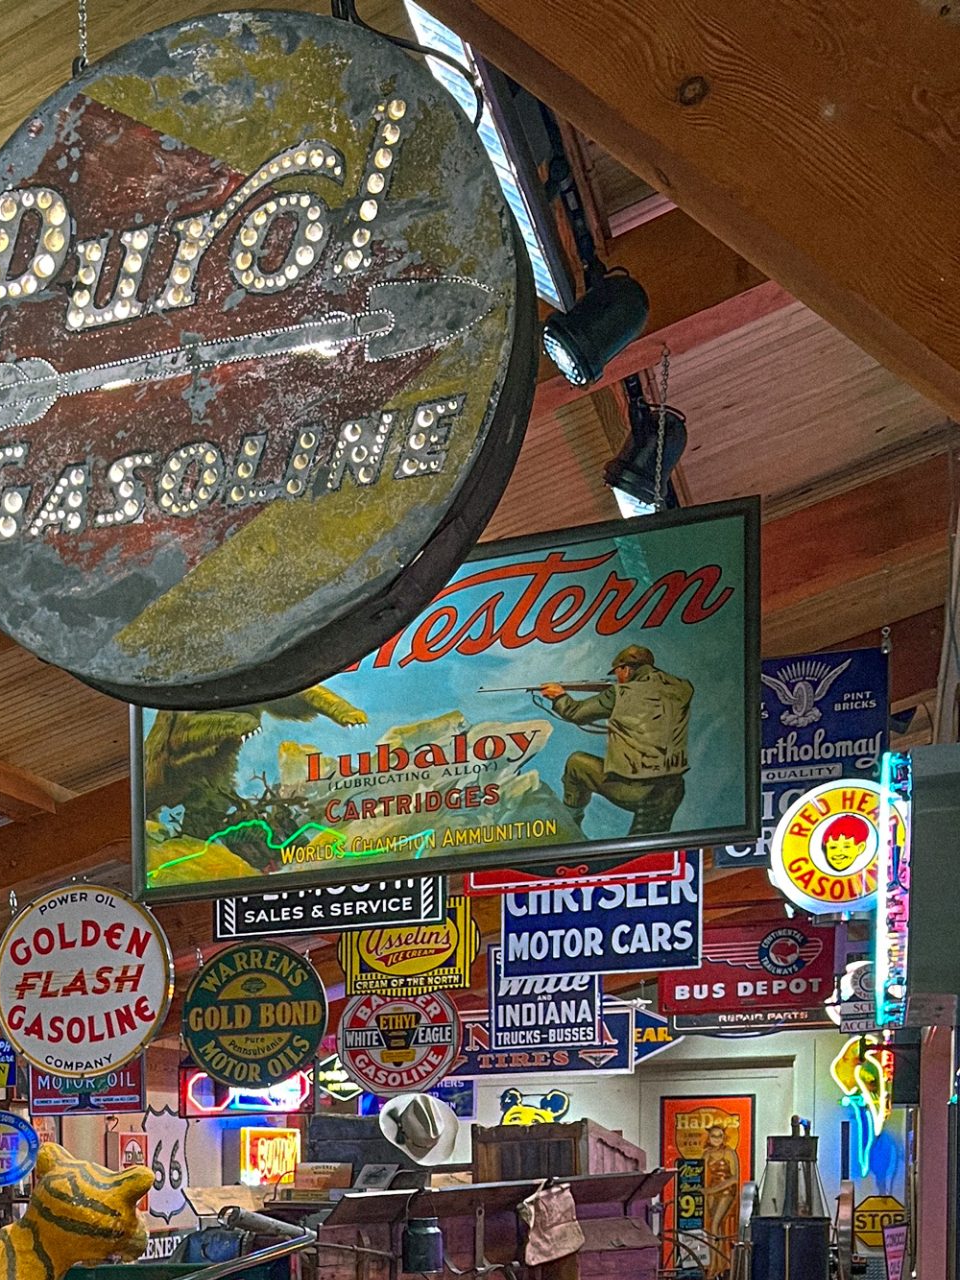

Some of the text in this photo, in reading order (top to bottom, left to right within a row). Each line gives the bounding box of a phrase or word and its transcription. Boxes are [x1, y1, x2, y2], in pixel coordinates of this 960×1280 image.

[833, 700, 877, 711] BRICKS
[843, 691, 872, 701] PINT
[305, 729, 544, 783] Lubaloy
[328, 761, 499, 792] (LUBRICATING ALLOY)
[766, 767, 836, 780] QUALITY
[325, 783, 501, 823] CARTRIDGES
[789, 797, 831, 838] RED
[281, 818, 558, 865] WORLD'S CHAMPION AMMUNITION
[506, 862, 698, 917] CHRYSLER
[38, 892, 117, 915] POWER OIL
[244, 897, 413, 923] SALES & SERVICE
[10, 920, 152, 966] GOLDEN
[508, 920, 694, 962] MOTOR CARS
[761, 929, 804, 949] CONTINENTAL
[388, 949, 436, 965] ICE CREAM
[761, 956, 799, 975] TRAILWAYS
[15, 964, 145, 1000] FLASH
[200, 949, 309, 993] WARREN'S
[355, 975, 460, 990] CREAM OF THE NORTH
[675, 978, 822, 1000] BUS DEPOT
[7, 995, 156, 1044] GASOLINE
[190, 1000, 323, 1032] GOLD BOND
[379, 1013, 418, 1030] ETHYL
[498, 1000, 593, 1028] INDIANA
[718, 1012, 809, 1023] REPAIR PARTS
[345, 1031, 379, 1047] WHITE
[418, 1026, 452, 1043] EAGLE
[496, 1027, 594, 1046] TRUCKS-BUSSES
[45, 1054, 113, 1071] COMPANY
[199, 1040, 262, 1082] MOTOR
[267, 1035, 310, 1077] OILS
[355, 1051, 442, 1086] GASOLINE
[477, 1051, 569, 1069] TIRES
[38, 1072, 136, 1090] MOTOR OIL
[151, 1140, 182, 1190] 66
